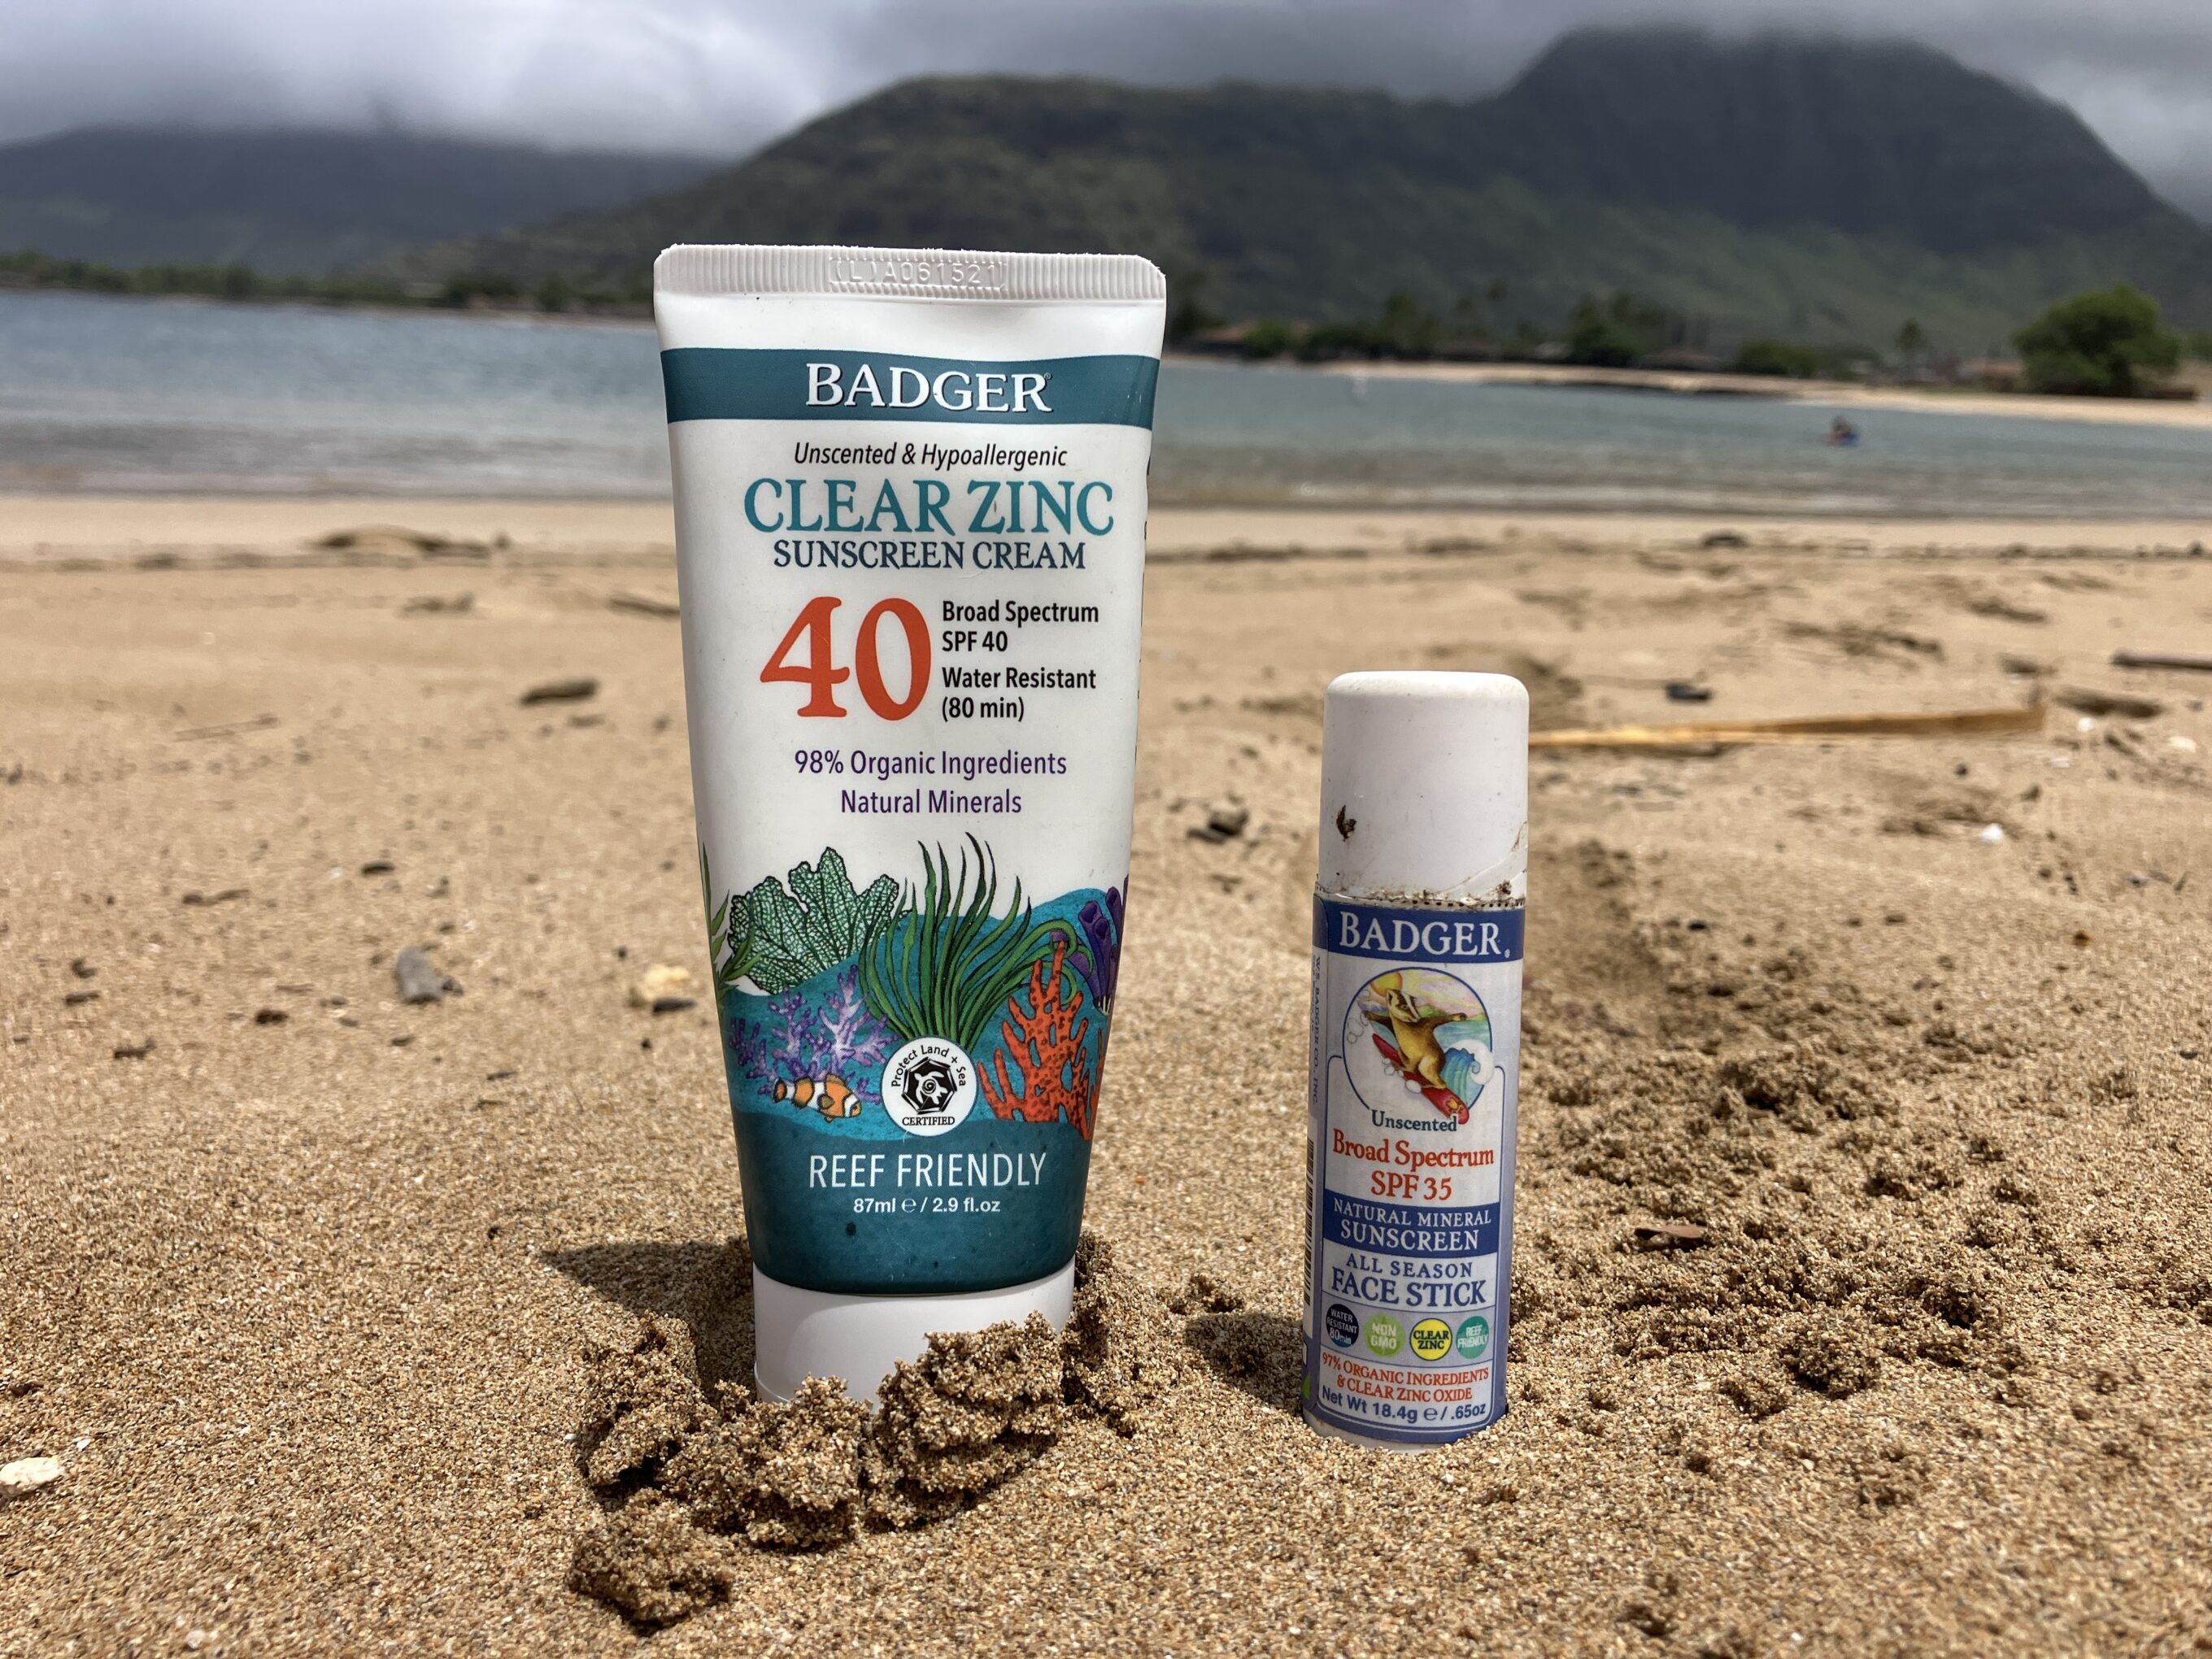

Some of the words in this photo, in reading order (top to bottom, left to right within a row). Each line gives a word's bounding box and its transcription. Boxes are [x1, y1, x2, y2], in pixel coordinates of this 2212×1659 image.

[795, 442, 897, 465] Unscented
[901, 445, 916, 465] &
[921, 444, 1068, 472] Hypoallergenic
[744, 477, 957, 536] CLEAR
[968, 481, 1114, 536] ZINC
[773, 540, 965, 569] SUNSCREEN
[973, 542, 1086, 569] CREAM
[942, 600, 999, 622] Broad
[1005, 600, 1099, 628] Spectrum
[942, 631, 978, 651] SPF
[982, 632, 1008, 652] 40
[760, 596, 931, 721] 40
[942, 667, 1001, 688] Water
[1006, 668, 1096, 689] Resistant
[942, 697, 973, 721] (80
[979, 697, 1025, 722] min)
[795, 751, 843, 774] 98%
[851, 751, 935, 780] Organic
[942, 750, 1067, 781] Ingredients
[841, 790, 920, 813] Natural
[929, 790, 1021, 814] Minerals
[891, 1050, 917, 1086] Protect
[921, 1045, 949, 1057] Land
[956, 1067, 966, 1086] Sea
[902, 1117, 955, 1126] CERTIFIED
[1371, 1110, 1457, 1131] Unscented
[1333, 1128, 1389, 1163] Broad
[1395, 1139, 1494, 1172] Spectrum
[810, 1154, 886, 1188] REEF
[898, 1152, 1047, 1187] FRIENDLY
[1371, 1171, 1419, 1198] SPF
[1424, 1177, 1452, 1200] 35
[854, 1198, 895, 1213] 87ml
[933, 1198, 958, 1213] 2.9
[964, 1198, 1000, 1213] fl.oz
[1335, 1198, 1412, 1226] NATURAL
[1417, 1209, 1491, 1227] MINERAL
[1341, 1219, 1478, 1251] SUNSCREEN
[1346, 1253, 1382, 1274] ALL
[1391, 1261, 1472, 1278] SEASON
[1331, 1265, 1400, 1304] FACE
[1406, 1280, 1487, 1307] STICK
[1327, 1317, 1357, 1334] RESISTANT
[1331, 1308, 1352, 1323] WATER
[1372, 1322, 1396, 1335] NON
[1371, 1336, 1396, 1349] GMO
[1413, 1330, 1450, 1340] CLEAR
[1417, 1341, 1444, 1349] ZINC
[1466, 1325, 1483, 1337] REEF
[1322, 1352, 1340, 1370] 97%
[1343, 1361, 1404, 1384] ORGANIC
[1407, 1367, 1489, 1386] INGREDIENTS
[1337, 1374, 1345, 1387] &
[1347, 1378, 1395, 1400] CLEAR
[1396, 1387, 1430, 1402] ZINC
[1434, 1388, 1472, 1402] OXIDE
[1322, 1385, 1343, 1406] Net
[1347, 1395, 1366, 1413] Wt
[1373, 1402, 1417, 1423] 18.4g
[1451, 1404, 1486, 1419] .65oz
